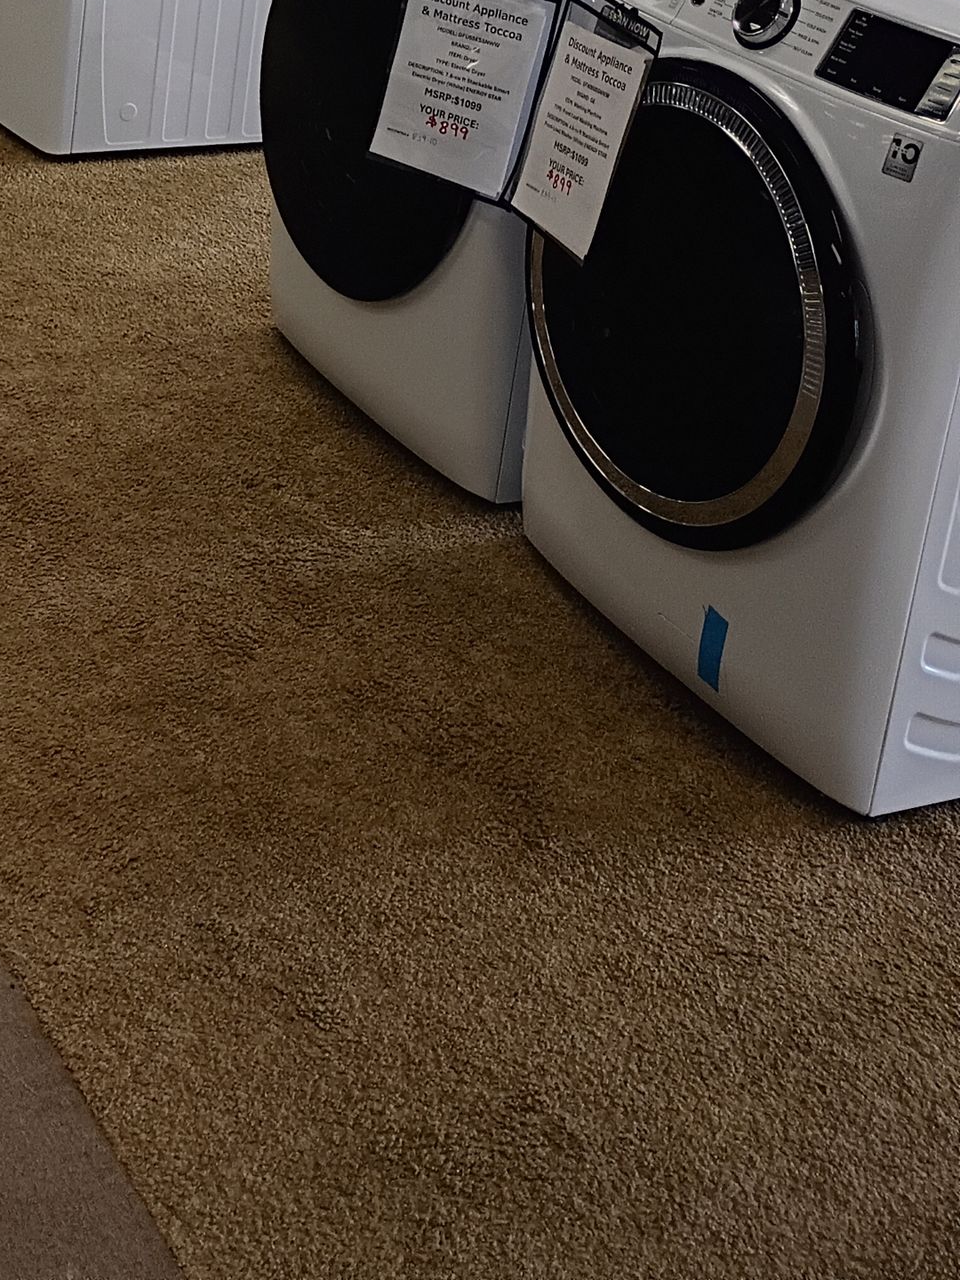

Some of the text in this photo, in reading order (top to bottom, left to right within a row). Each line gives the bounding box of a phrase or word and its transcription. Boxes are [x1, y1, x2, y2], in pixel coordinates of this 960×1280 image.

[421, 5, 522, 40] & Mattress Toccoa
[473, 4, 528, 27] Appliance
[568, 37, 632, 77] Discount Appliance
[564, 53, 571, 64] &
[571, 57, 599, 77] Mattress
[600, 71, 626, 91] Toccoa
[425, 88, 481, 111] MSRP:$1099
[419, 104, 478, 129] YOUR PRICE:
[425, 114, 469, 140] $899
[545, 166, 572, 198] $899
[548, 157, 584, 186] YOUR PRICE:
